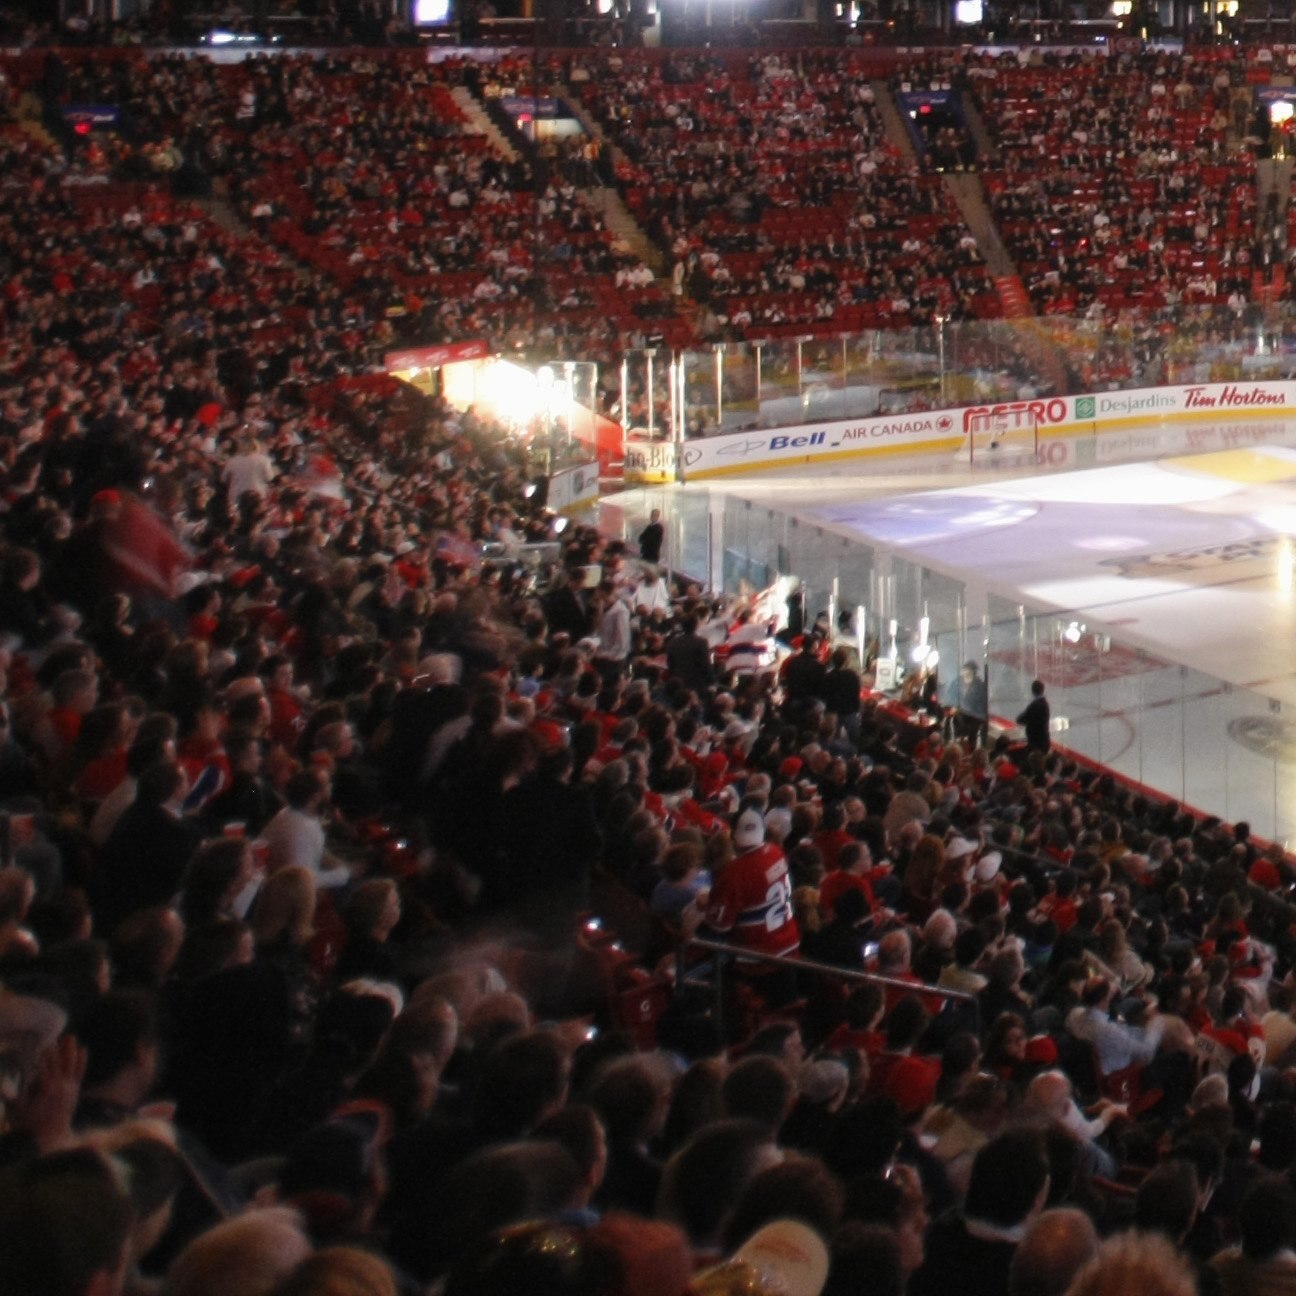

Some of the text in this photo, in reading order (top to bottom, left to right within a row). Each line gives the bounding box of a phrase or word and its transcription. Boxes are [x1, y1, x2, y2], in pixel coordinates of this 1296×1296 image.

[1100, 394, 1176, 414] Desjardins
[1183, 386, 1286, 409] Tim Hortons
[963, 398, 1067, 434] METRO
[768, 431, 826, 451] Bell
[841, 420, 933, 441] AIR CANADA
